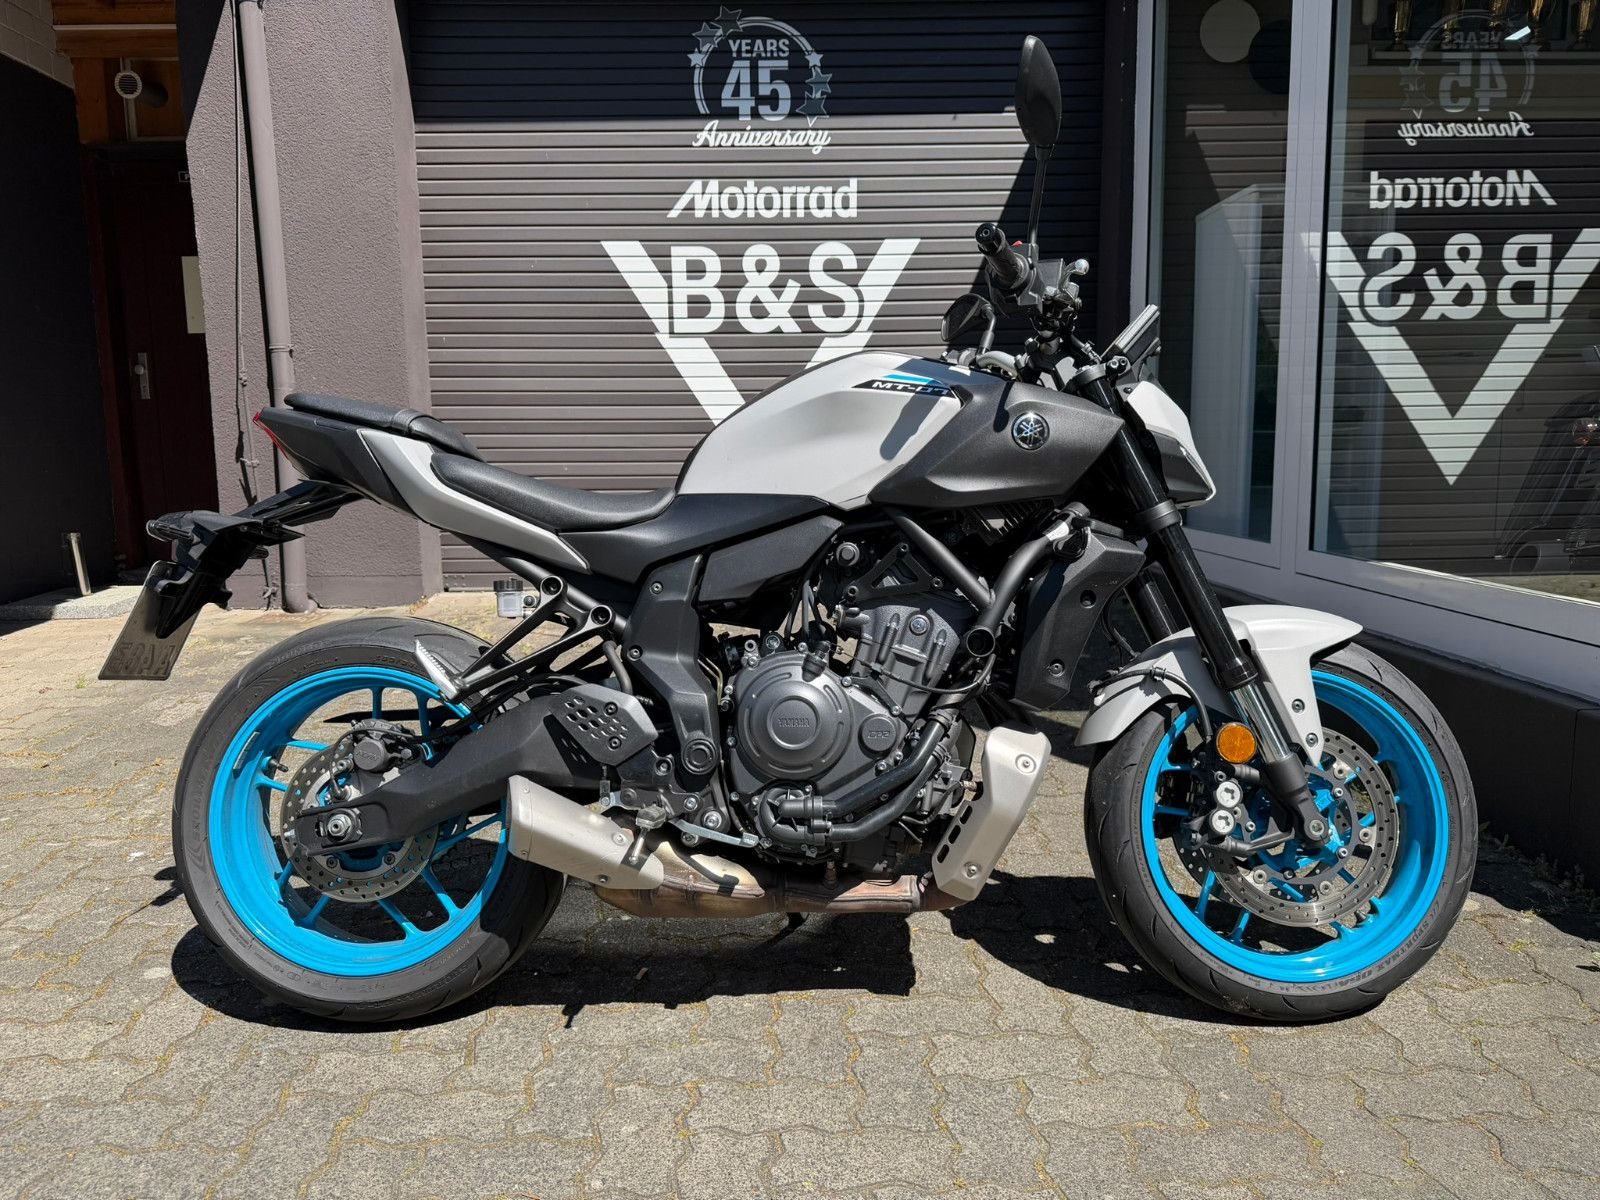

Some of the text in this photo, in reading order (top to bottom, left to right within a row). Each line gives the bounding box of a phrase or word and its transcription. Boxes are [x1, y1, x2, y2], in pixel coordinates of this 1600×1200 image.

[728, 38, 790, 58] YEARS
[720, 60, 791, 121] 45
[692, 119, 831, 154] Anniversary
[666, 178, 858, 218] Motorrad
[670, 241, 860, 333] B&S
[871, 381, 949, 395] MT-07
[778, 717, 810, 728] YAMAHA
